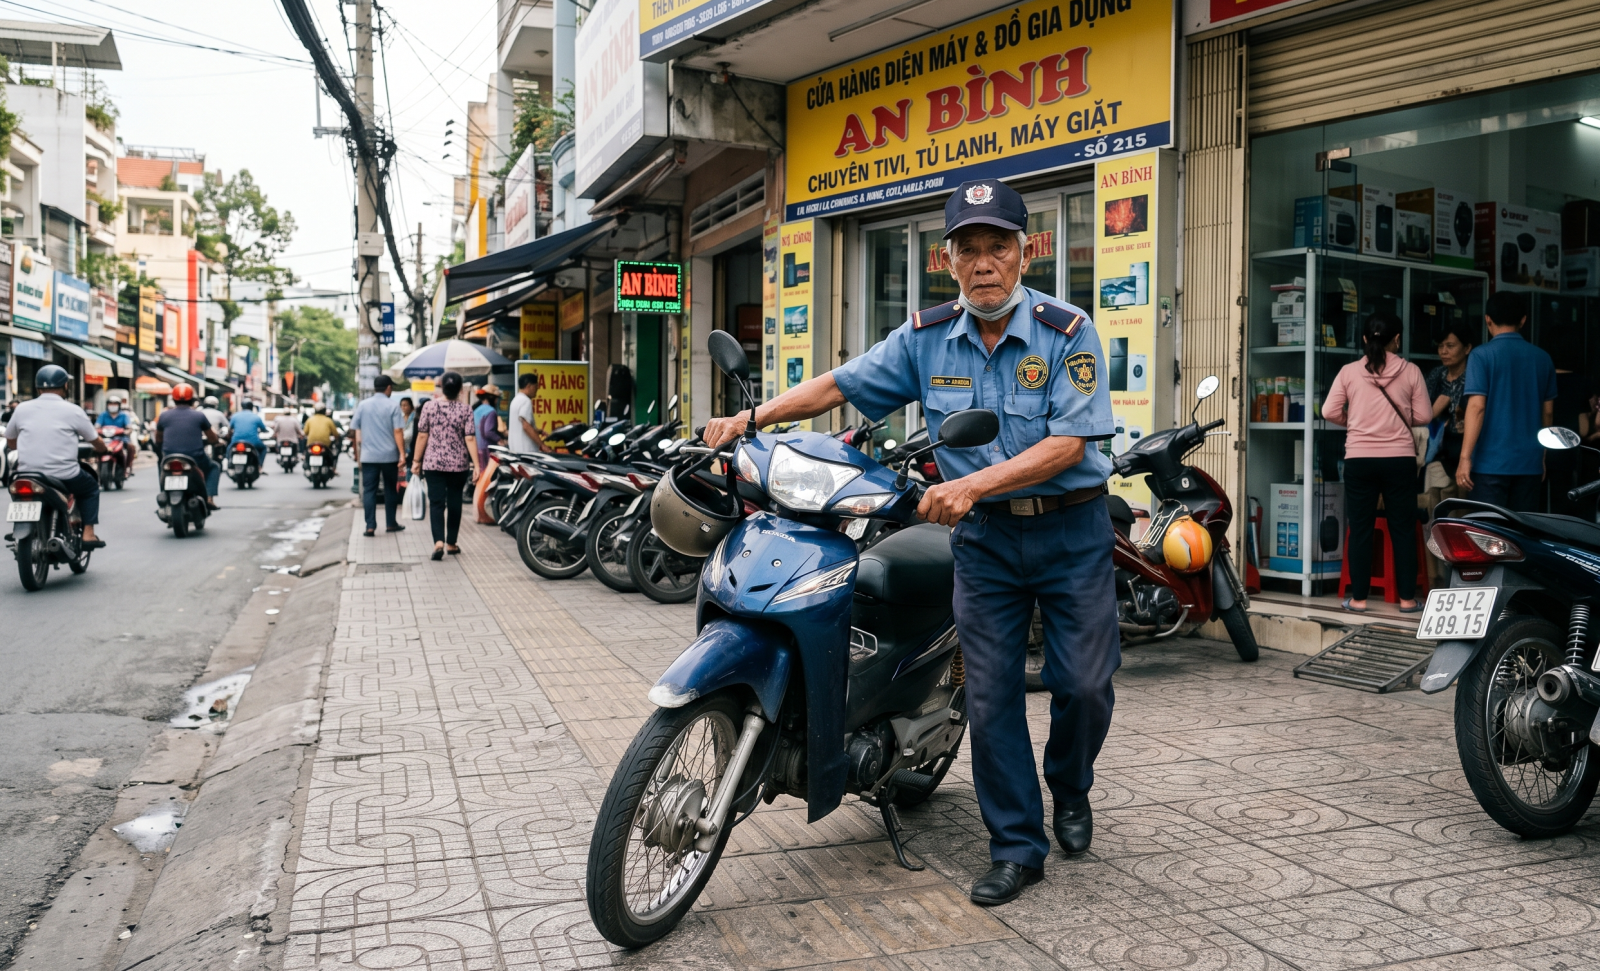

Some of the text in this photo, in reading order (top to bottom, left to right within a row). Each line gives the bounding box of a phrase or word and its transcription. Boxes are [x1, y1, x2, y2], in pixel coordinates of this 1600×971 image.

[807, 77, 835, 110] CỬA
[839, 66, 880, 101] HÀNG
[885, 51, 924, 86] DIỆN
[929, 34, 969, 72] MÁY
[974, 30, 989, 57] &
[994, 8, 1021, 51] ĐỒ
[1028, 6, 1063, 41] GIA
[582, 60, 599, 126] AN
[834, 46, 1091, 158] AN BÌNH
[808, 160, 869, 193] CHUYÊN
[874, 153, 911, 179] TIVI,
[916, 138, 939, 169] TỦ
[945, 131, 1003, 165] LẠNH,
[1010, 114, 1059, 148] MÁY
[1066, 98, 1122, 134] GIẶT
[1083, 134, 1108, 159] SỐ
[1113, 133, 1147, 153] 215
[1100, 172, 1118, 189] AN
[621, 267, 678, 297] AN BÌNH
[551, 370, 585, 391] HÀNG
[556, 395, 584, 415] MÁN
[1435, 591, 1486, 612] 59-L2
[1424, 613, 1485, 636] 489.15
